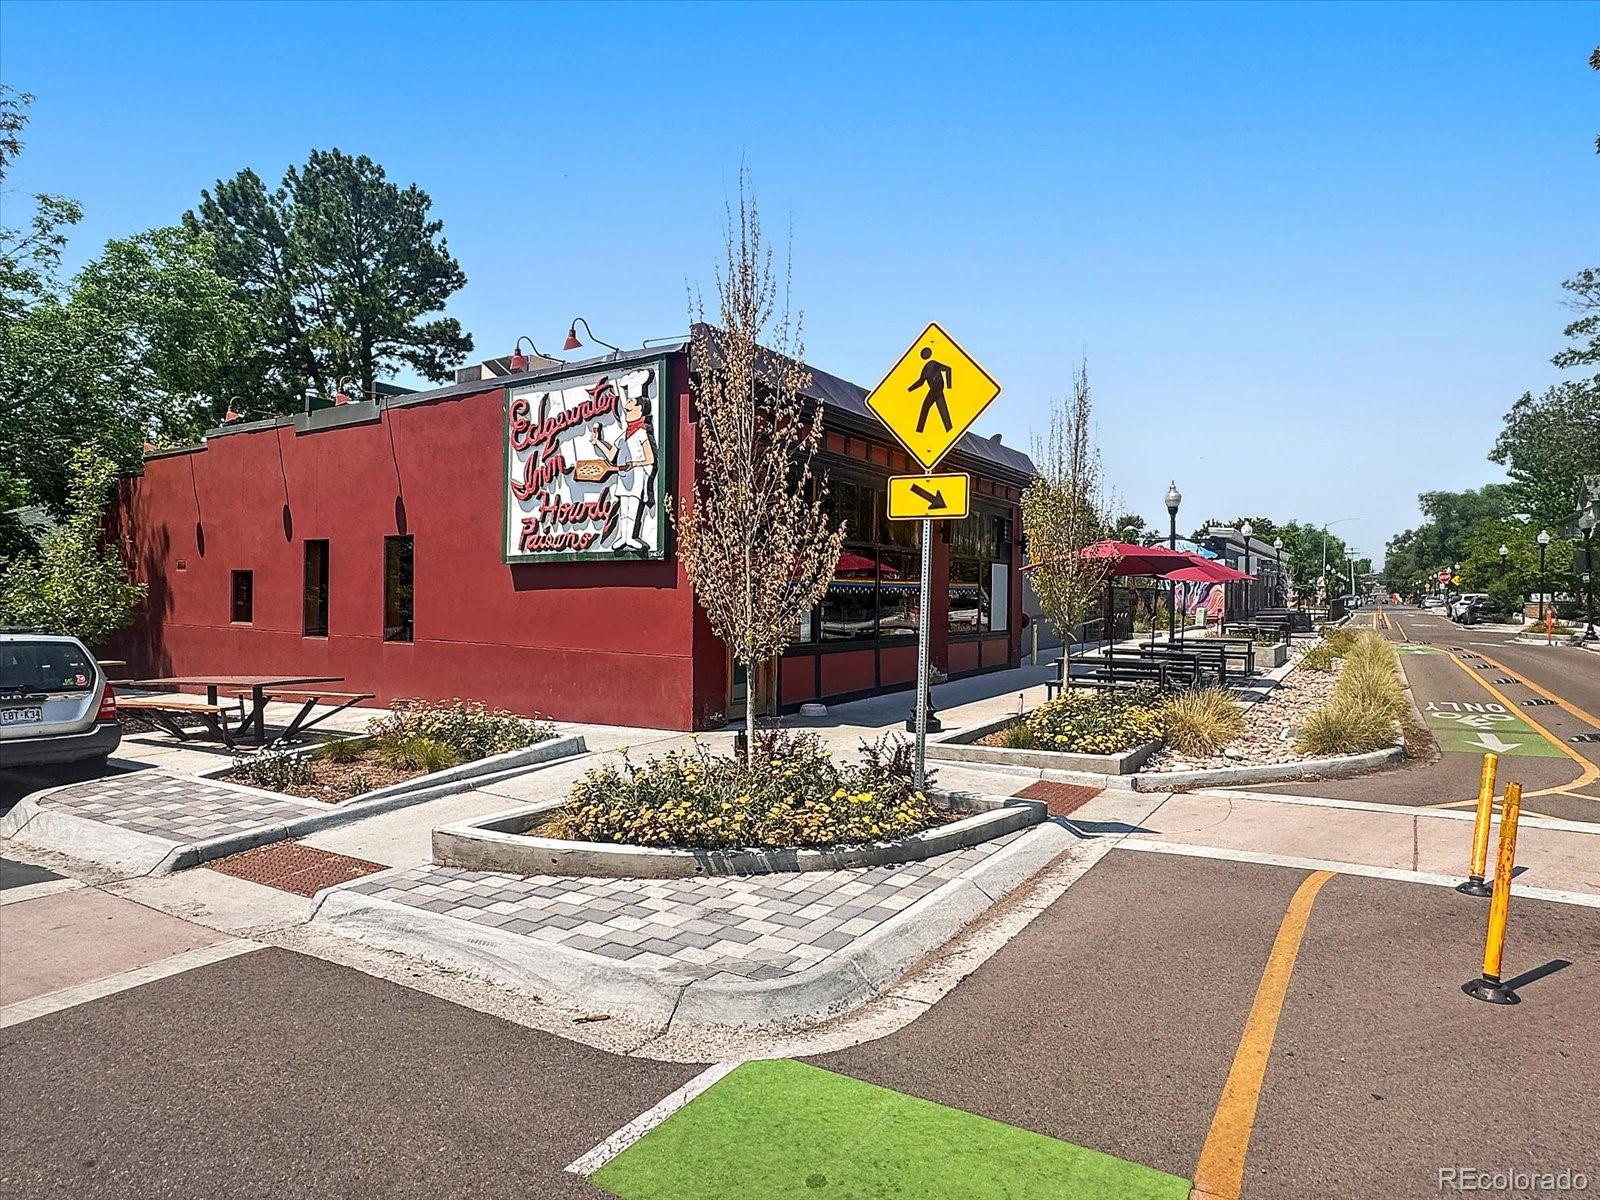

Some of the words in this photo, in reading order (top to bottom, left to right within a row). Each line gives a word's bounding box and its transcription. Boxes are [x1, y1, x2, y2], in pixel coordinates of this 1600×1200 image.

[510, 377, 621, 460] Edgewater
[511, 451, 574, 500] Inn
[536, 487, 621, 545] Howdy
[1425, 701, 1506, 713] ONLY
